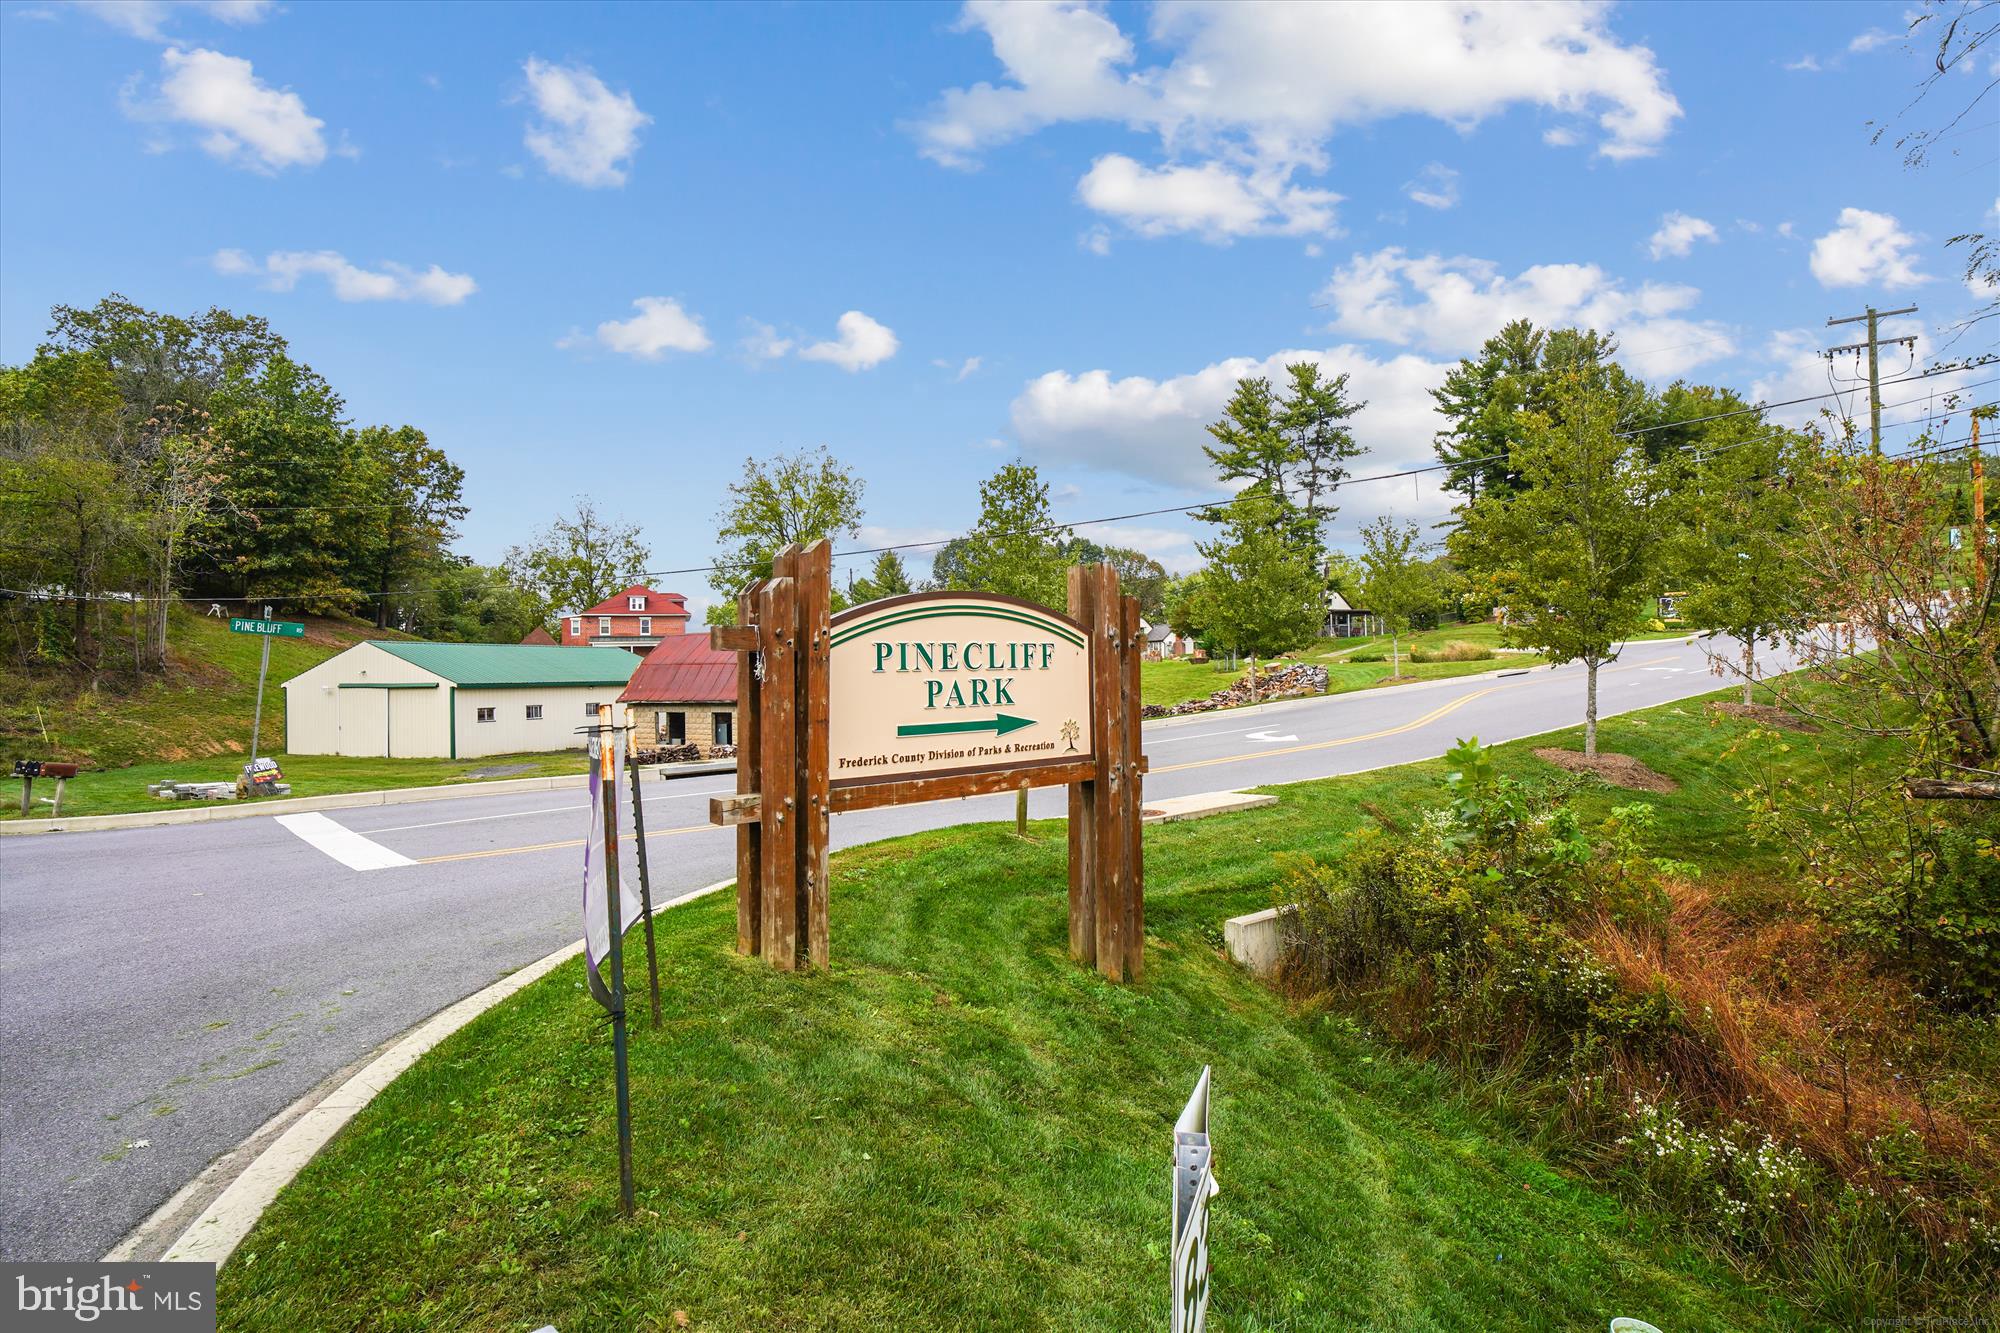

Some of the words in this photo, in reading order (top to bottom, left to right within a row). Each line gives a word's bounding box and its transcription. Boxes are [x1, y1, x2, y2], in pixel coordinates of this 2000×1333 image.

[235, 621, 255, 632] PINE
[257, 623, 283, 634] BLUFF
[872, 642, 1055, 673] PINECLIFF
[924, 677, 1015, 709] PARK
[244, 761, 278, 773] FEWOOD
[838, 755, 889, 769] Frederick
[891, 753, 925, 764] County
[928, 748, 965, 761] Division
[967, 747, 977, 757] of
[978, 746, 1002, 756] Parks
[1004, 744, 1012, 754] &
[1014, 741, 1055, 753] Recreation
